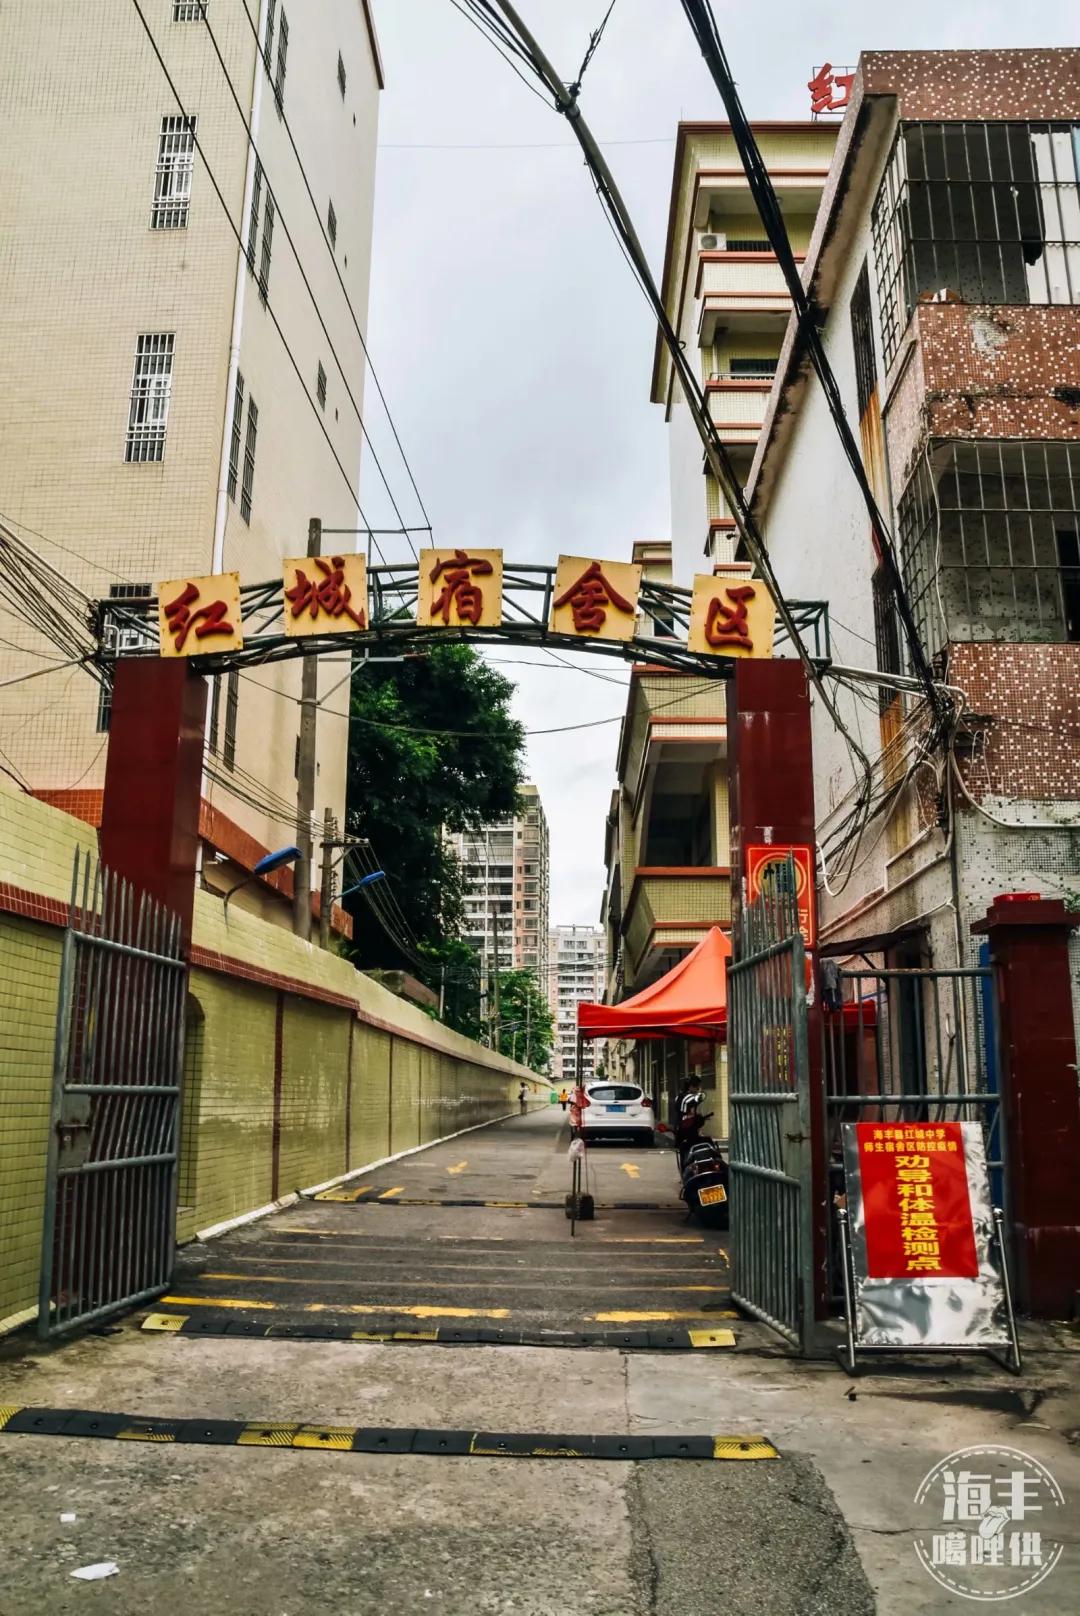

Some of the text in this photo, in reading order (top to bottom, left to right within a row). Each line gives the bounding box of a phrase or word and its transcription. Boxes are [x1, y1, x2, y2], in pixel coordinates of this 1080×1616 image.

[165, 550, 756, 652] 红城宿舍区
[894, 1155, 942, 1270] 劝导和体温检测点
